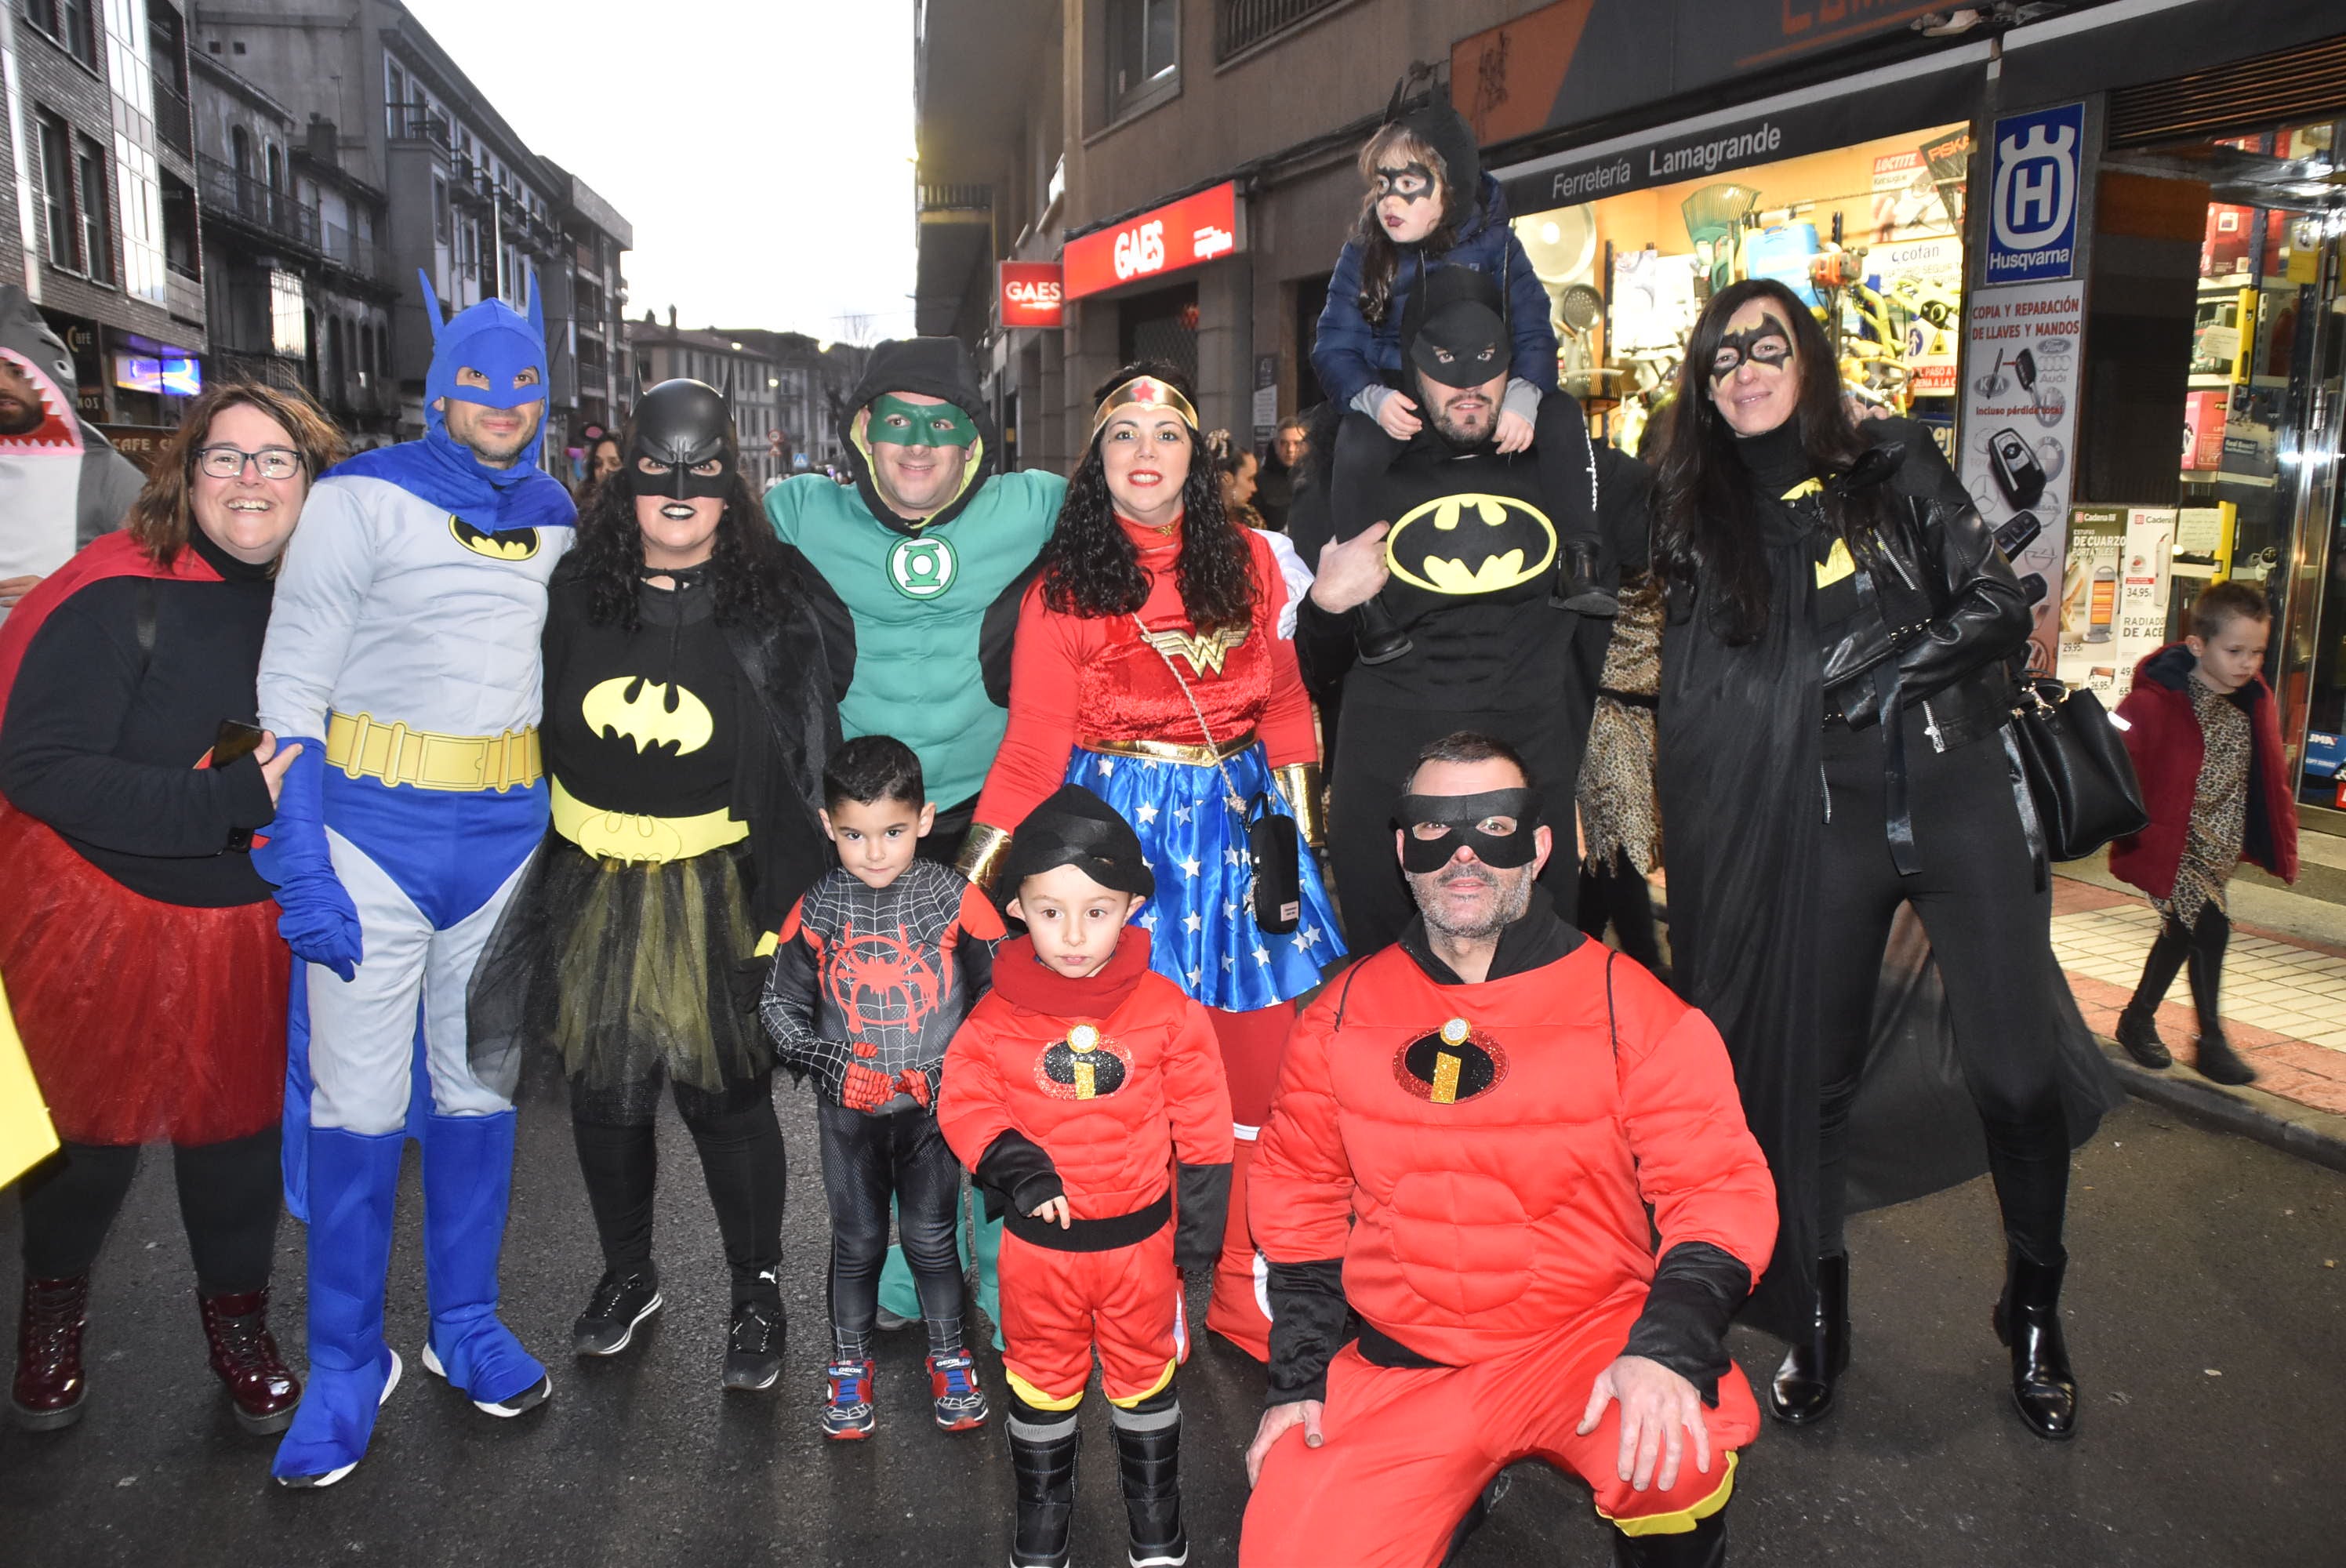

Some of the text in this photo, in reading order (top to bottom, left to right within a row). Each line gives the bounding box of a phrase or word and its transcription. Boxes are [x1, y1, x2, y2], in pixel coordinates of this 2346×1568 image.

[1552, 123, 1781, 198] Ferretería Lamagrande
[1875, 153, 1917, 172] LOCTITE
[1114, 220, 1164, 279] GAES
[1901, 245, 1939, 262] cofan
[1989, 249, 2069, 271] Husqvarna
[1005, 281, 1062, 301] GAES
[1973, 296, 2079, 319] COPIA Y REPARACIÓN
[1972, 321, 2079, 340] DE LLAVES Y MANDOS
[1976, 405, 2063, 416] Incluso pérdida total
[2073, 536, 2126, 546] DE CUARZO
[2123, 628, 2139, 637] DE
